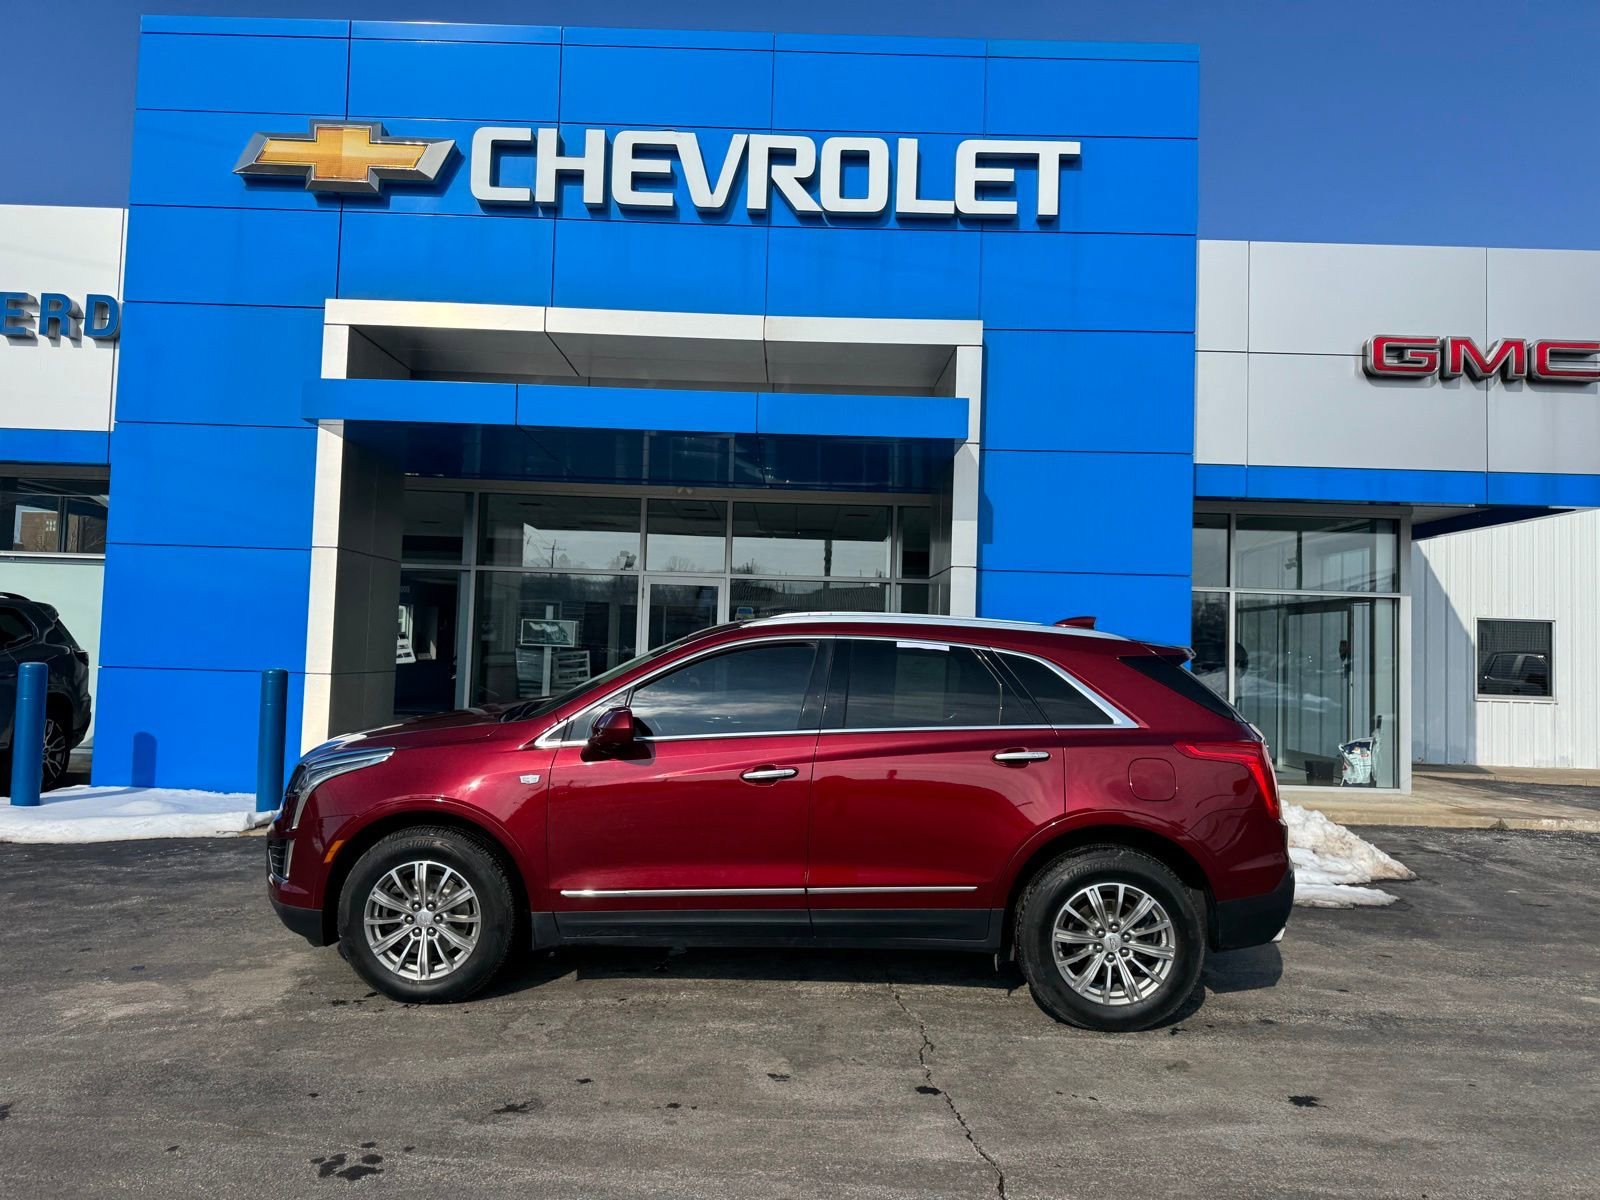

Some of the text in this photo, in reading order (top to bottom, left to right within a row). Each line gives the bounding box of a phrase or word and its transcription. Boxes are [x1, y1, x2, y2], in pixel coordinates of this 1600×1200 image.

[470, 126, 1081, 217] CHEVROLET
[0, 291, 120, 339] ERD
[1363, 334, 1600, 382] GMC
